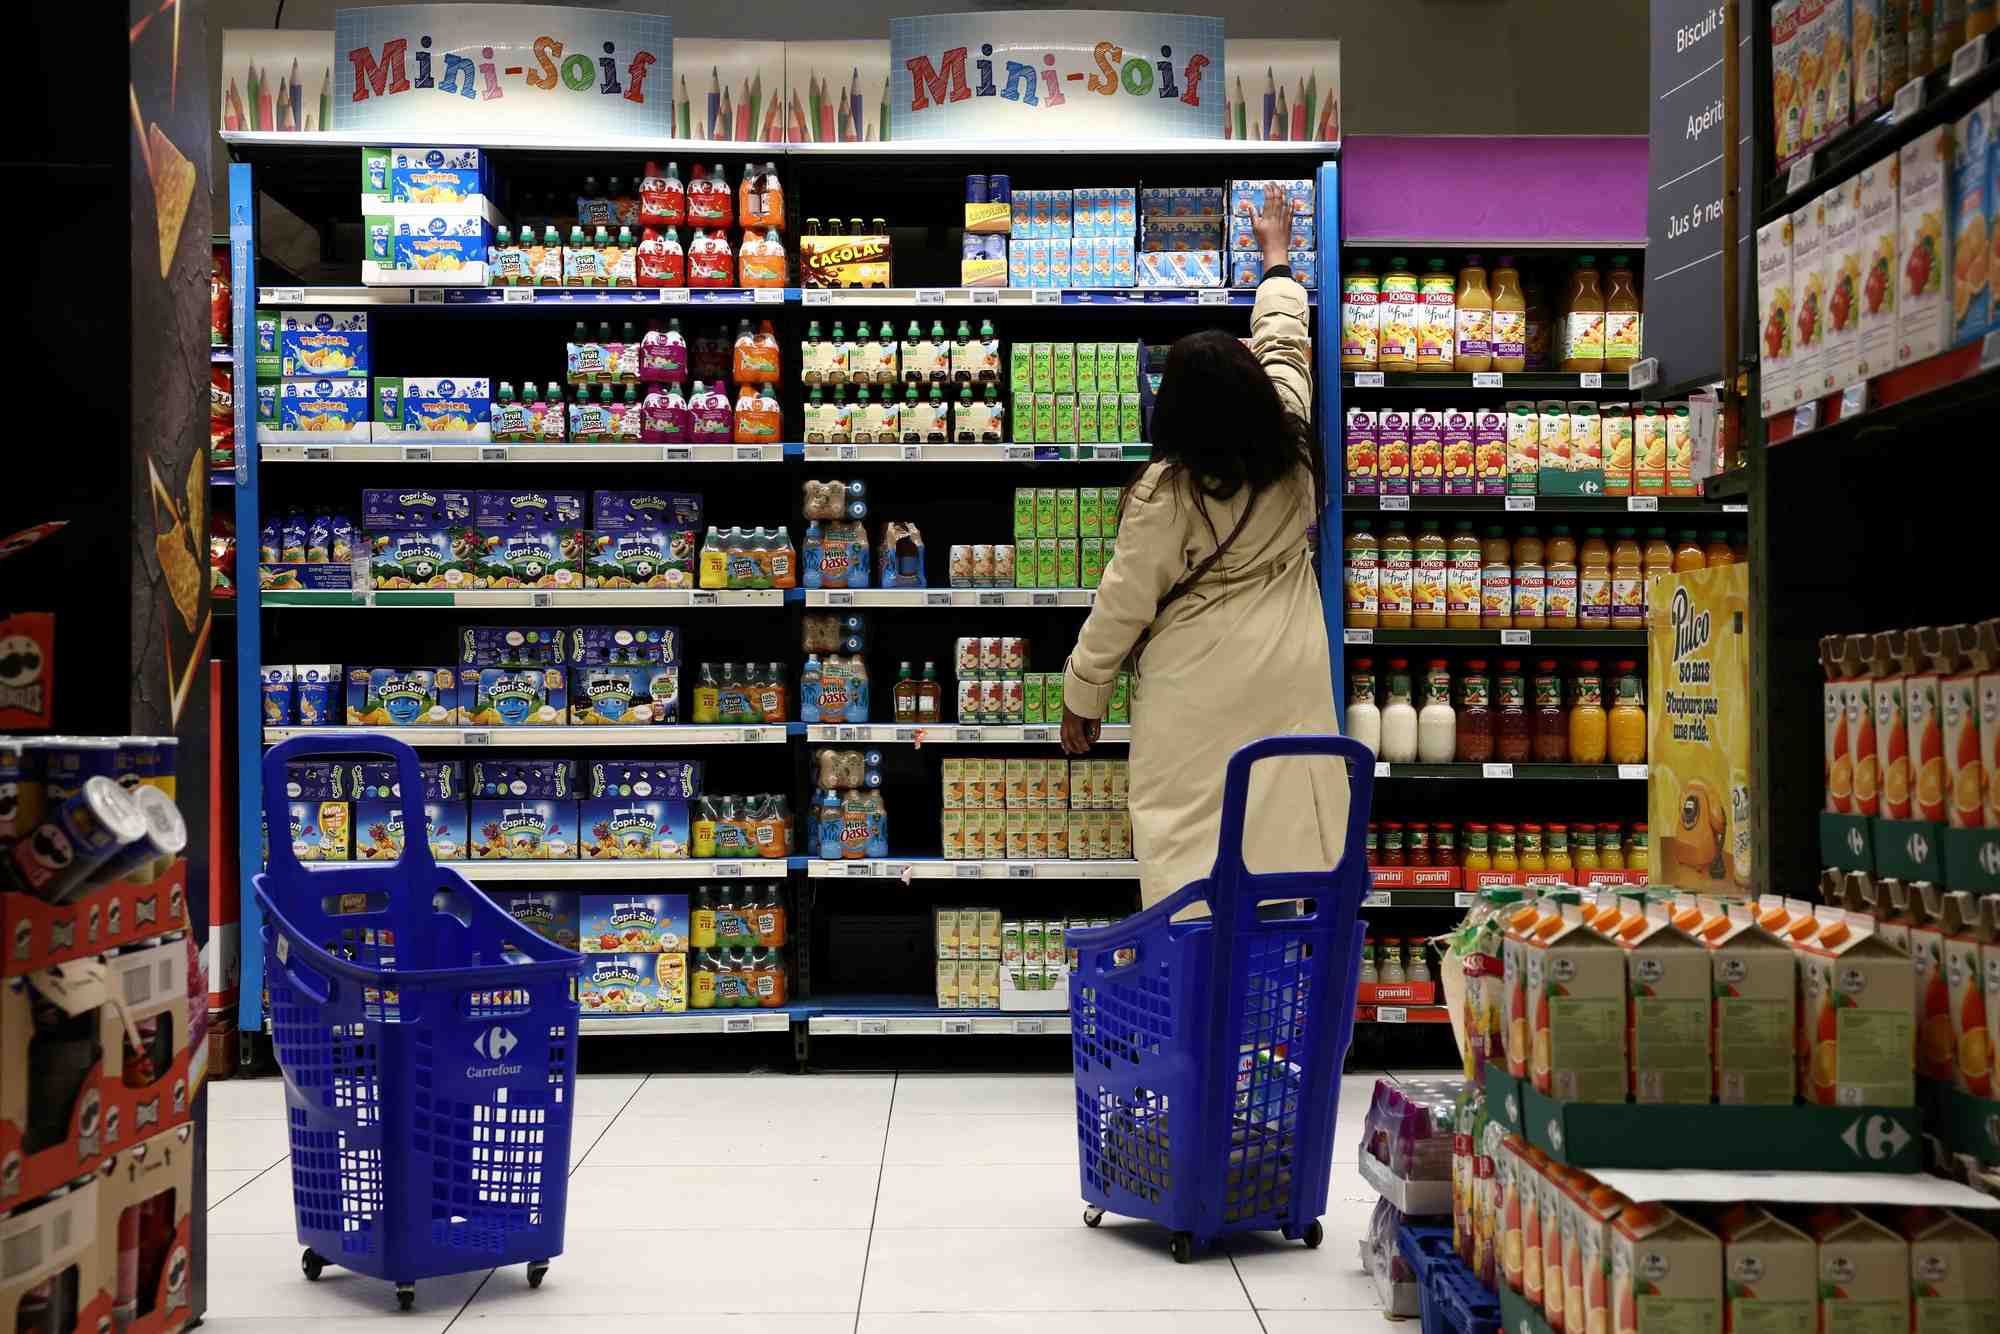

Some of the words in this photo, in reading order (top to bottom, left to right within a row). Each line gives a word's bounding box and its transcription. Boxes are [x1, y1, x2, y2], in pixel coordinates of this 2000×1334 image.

[1676, 9, 1717, 52] Biscuit
[349, 36, 657, 104] Mini-Soif
[905, 41, 1210, 112] Mini-Soif
[1685, 95, 1725, 141] Apériti
[1667, 215, 1690, 241] Jus
[1692, 204, 1702, 229] &
[501, 254, 520, 264] Fruit
[577, 255, 594, 264] Fruit
[809, 243, 884, 268] CACOLAC
[581, 351, 598, 360] Fruit
[504, 412, 521, 421] Fruit
[582, 413, 600, 421] Fruit
[399, 491, 437, 505] Capri-Sun
[510, 493, 548, 506] Capri-Sun
[394, 545, 443, 560] Capri-Sun
[504, 545, 552, 561] Capri-Sun
[614, 546, 663, 561] Capri-Sun
[820, 557, 849, 570] Oasis
[1671, 587, 1712, 663] Pulco
[1679, 662, 1691, 683] 50
[1692, 660, 1710, 683] ans
[378, 681, 427, 696] Capri-Sun
[488, 681, 536, 696] Capri-Sun
[586, 682, 635, 697] Capri-Sun
[819, 691, 848, 705] Oasis
[1665, 692, 1702, 718] Toujours
[1703, 697, 1718, 718] pas
[1673, 723, 1688, 740] une
[1690, 722, 1710, 742] ride.
[500, 817, 547, 831] Capri-Sun
[611, 817, 657, 831] Capri-Sun
[840, 828, 870, 841] Oasis
[1375, 872, 1401, 881] anini
[1415, 872, 1448, 884] granini
[1480, 874, 1513, 885] granini
[1528, 874, 1561, 885] granini
[510, 907, 554, 920] apri-Sun
[610, 911, 657, 925] Capri-Sun
[593, 968, 640, 983] Capri-Sun
[1378, 987, 1410, 999] granini
[466, 1063, 523, 1079] Carrefour
